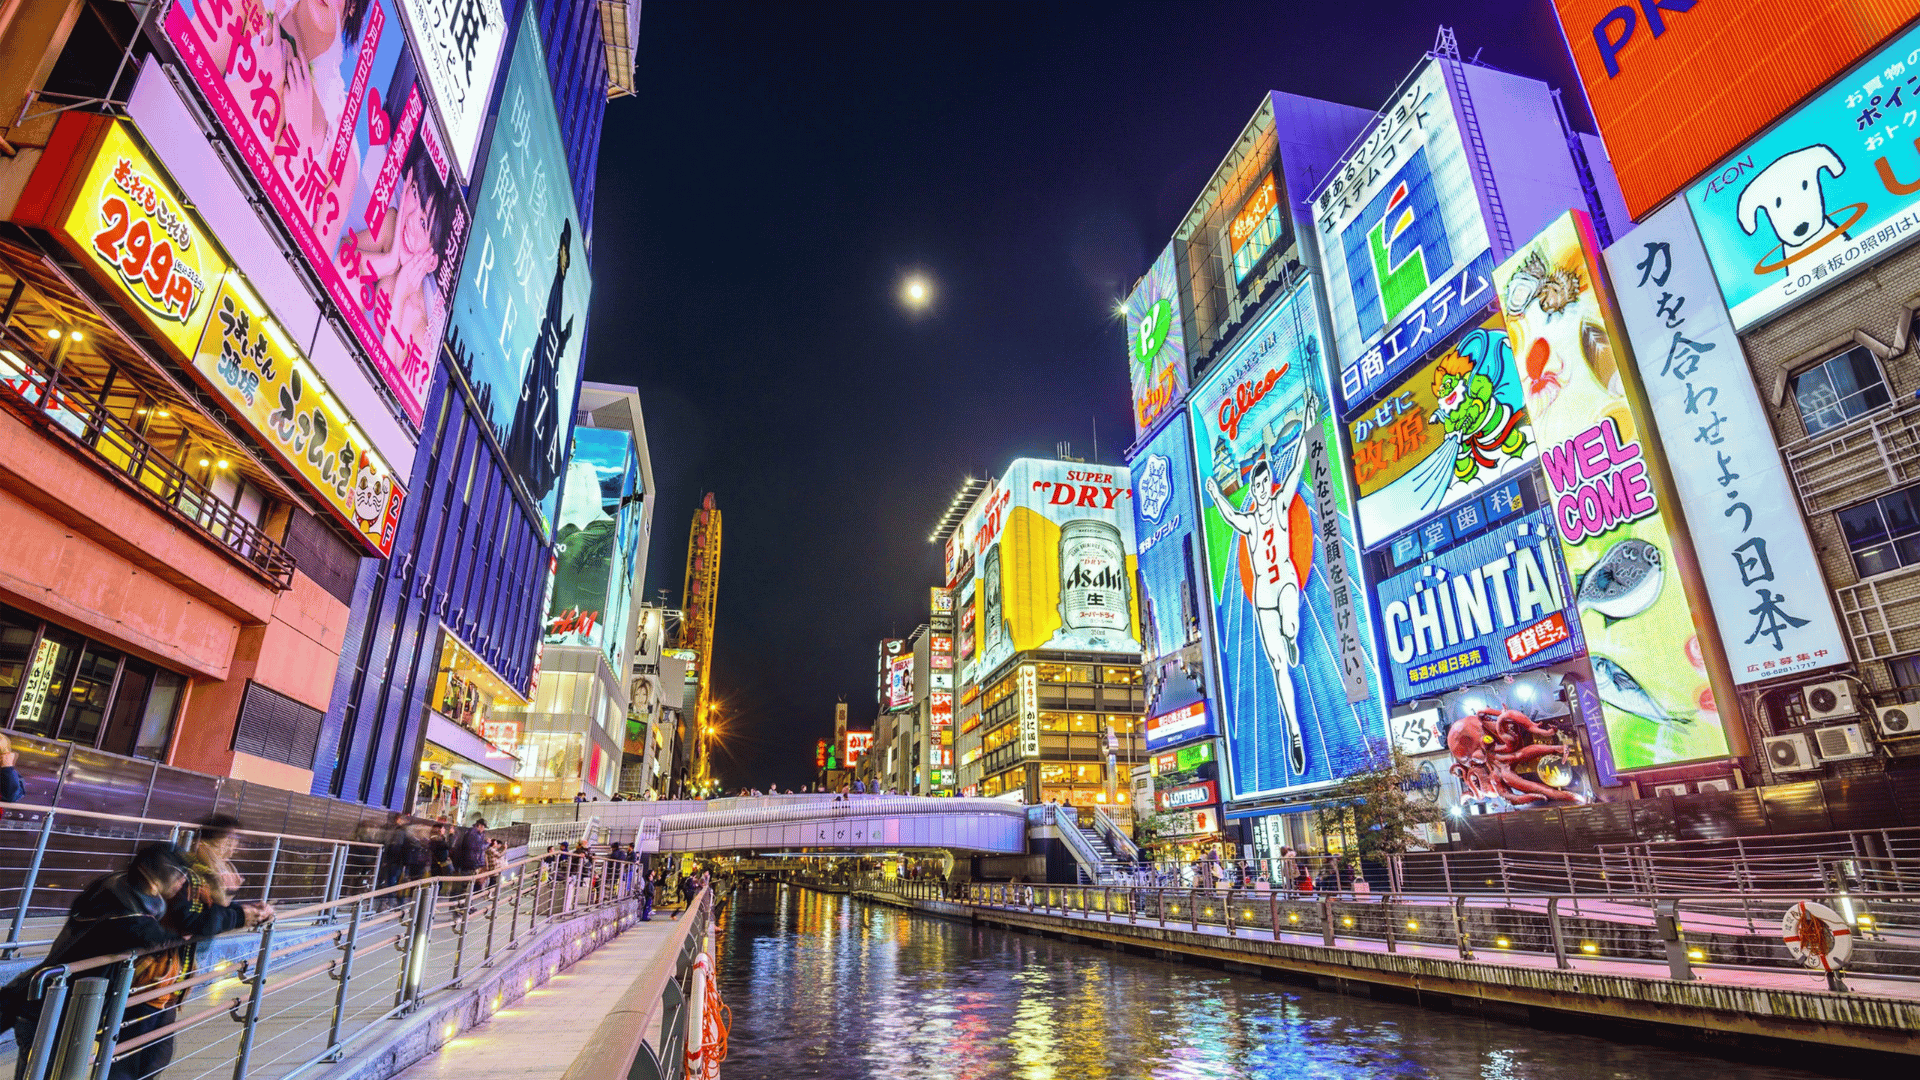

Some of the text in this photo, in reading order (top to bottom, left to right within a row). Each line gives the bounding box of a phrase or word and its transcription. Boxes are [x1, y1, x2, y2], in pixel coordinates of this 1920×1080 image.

[369, 114, 384, 140] VS
[422, 122, 448, 181] NMB48
[1319, 85, 1421, 213] 夢あるマンション
[1323, 111, 1430, 234] エステムコート
[94, 199, 196, 320] 299円
[218, 294, 276, 382] うまいもん
[474, 227, 559, 475] REGZA
[1340, 269, 1491, 400] 日商エステム
[217, 340, 261, 407] 酒場
[1137, 362, 1175, 429] ピップ
[1218, 362, 1290, 441] Glico
[1351, 405, 1428, 487] 改源
[1353, 389, 1416, 444] かぜに
[1636, 241, 1813, 652] 力を合わせよう日本
[1066, 470, 1113, 484] SUPER
[1540, 418, 1641, 495] WEL
[381, 492, 401, 547] 2F
[1556, 460, 1656, 543] COME
[1066, 562, 1122, 592] Asahi
[1262, 524, 1281, 585] グリコ
[1310, 439, 1363, 686] みんなに笑顔を届けたい。
[551, 610, 599, 638] H&M
[1087, 592, 1105, 607] 生
[1408, 649, 1483, 684] 毎週水曜日発売
[1506, 628, 1538, 662] 賃貸
[1566, 683, 1579, 714] 2F
[1401, 717, 1432, 749] くくる
[1169, 787, 1206, 805] LOTTERIA
